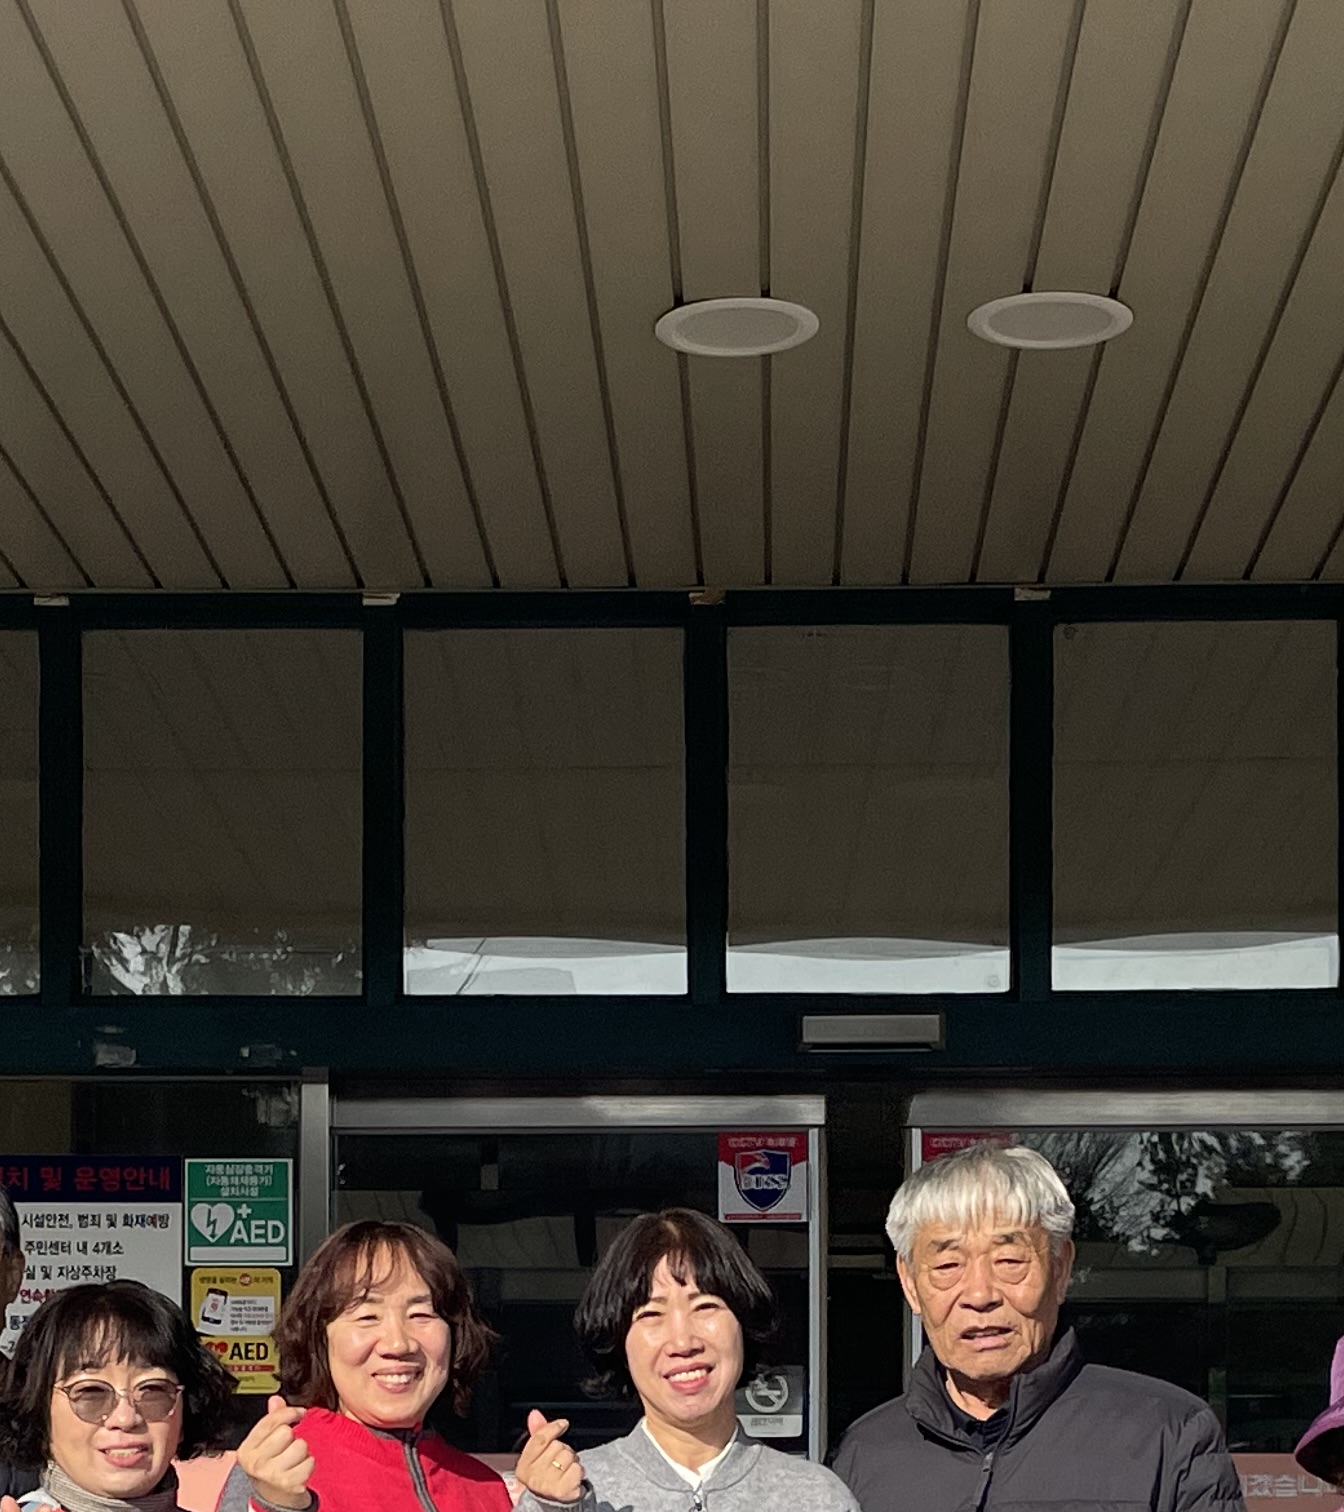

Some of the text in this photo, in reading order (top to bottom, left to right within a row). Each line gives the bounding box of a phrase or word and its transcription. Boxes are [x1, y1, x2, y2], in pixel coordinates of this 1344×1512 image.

[40, 1167, 62, 1191] 및
[75, 1167, 172, 1192] 운영안내
[77, 1213, 101, 1228] 범죄
[106, 1214, 118, 1228] 및
[122, 1213, 170, 1229] 화재예방
[230, 1219, 286, 1244] AED
[76, 1241, 88, 1255] 내
[91, 1241, 125, 1255] 4개소
[40, 1265, 52, 1280] 및
[57, 1265, 117, 1281] 지상주차장
[229, 1342, 269, 1361] AED
